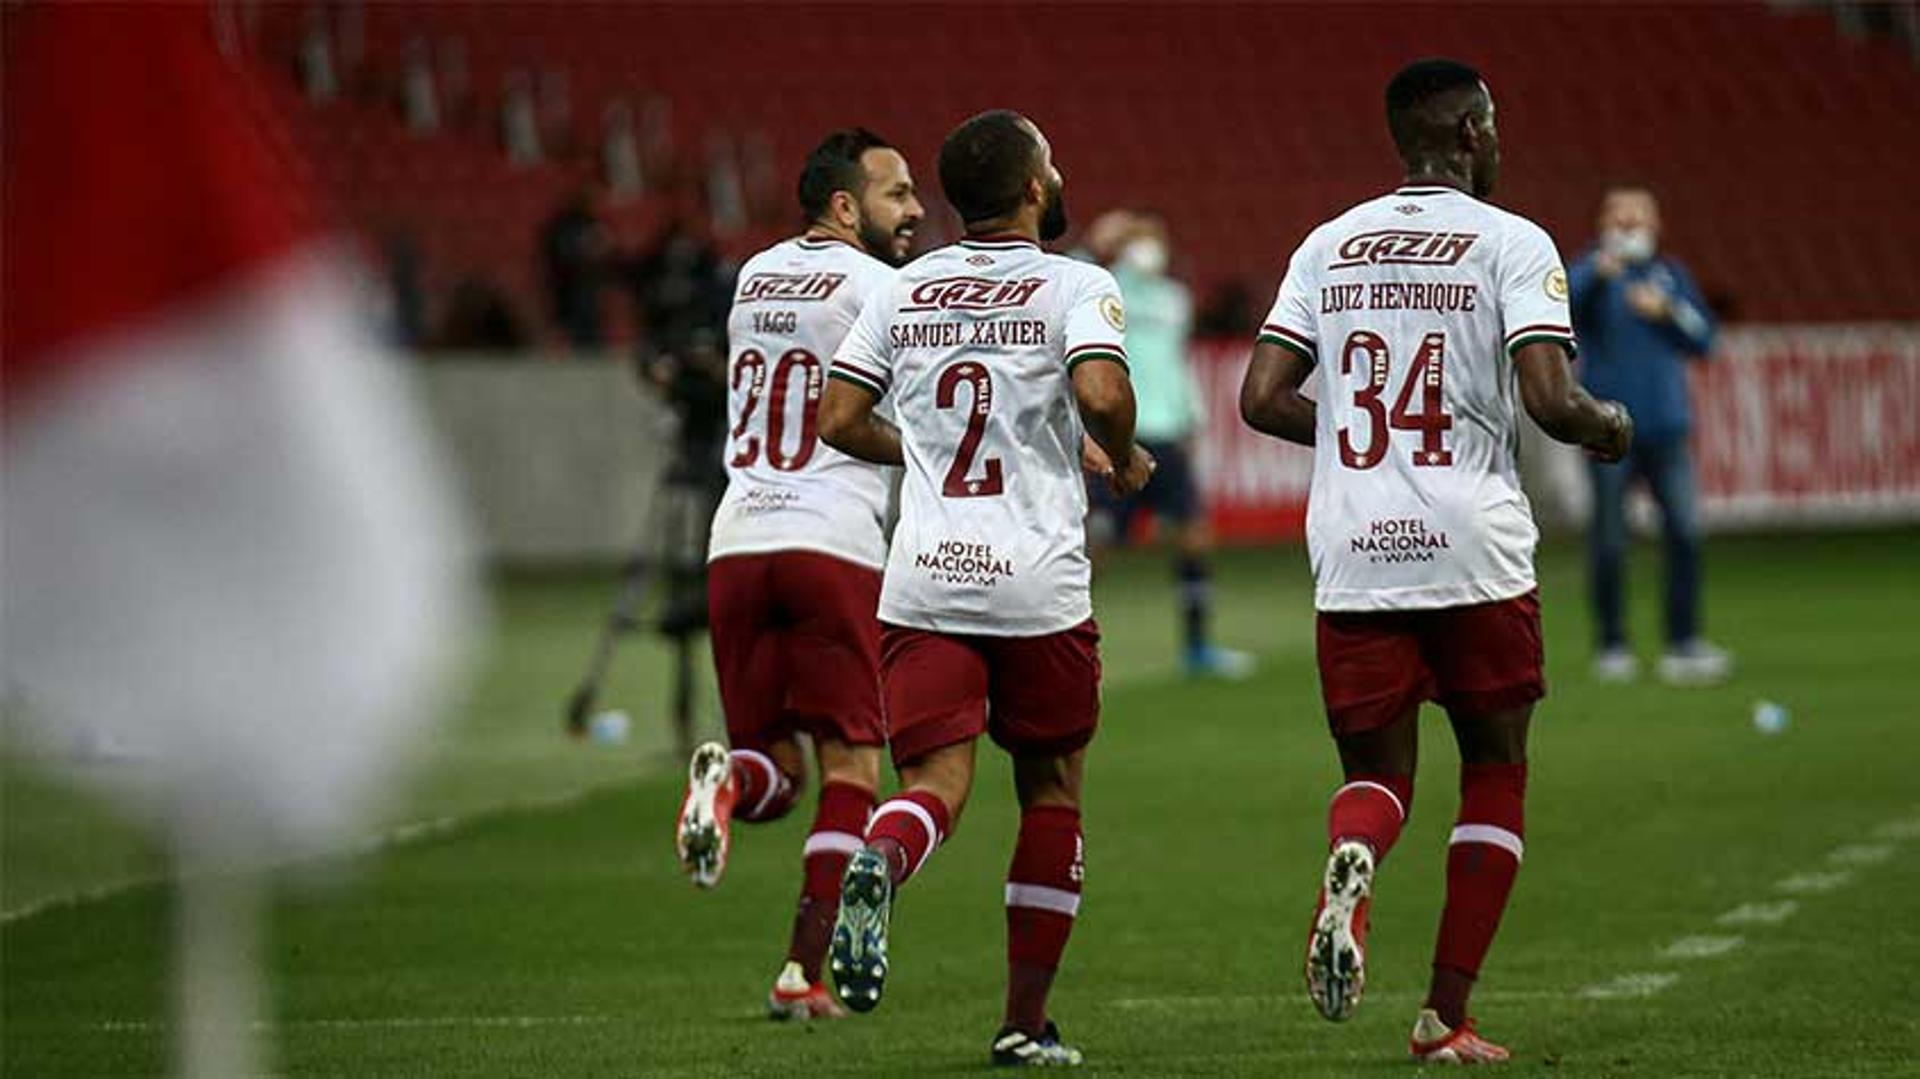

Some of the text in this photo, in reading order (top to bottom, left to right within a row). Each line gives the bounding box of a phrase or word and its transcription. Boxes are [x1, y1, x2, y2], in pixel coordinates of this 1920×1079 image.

[1328, 229, 1480, 271] GAZIN
[899, 276, 1048, 313] GAZIN
[1321, 282, 1478, 314] LUIZ HENRIQUE
[889, 320, 1047, 349] SAMUEL XAVIER
[731, 347, 822, 472] 20
[1338, 330, 1453, 470] 34
[935, 360, 1004, 498] 2
[1350, 532, 1450, 553] NACIONAL
[1371, 518, 1427, 535] HOTEL
[915, 553, 1014, 577] NACIONAL
[937, 541, 992, 558] HOTEL
